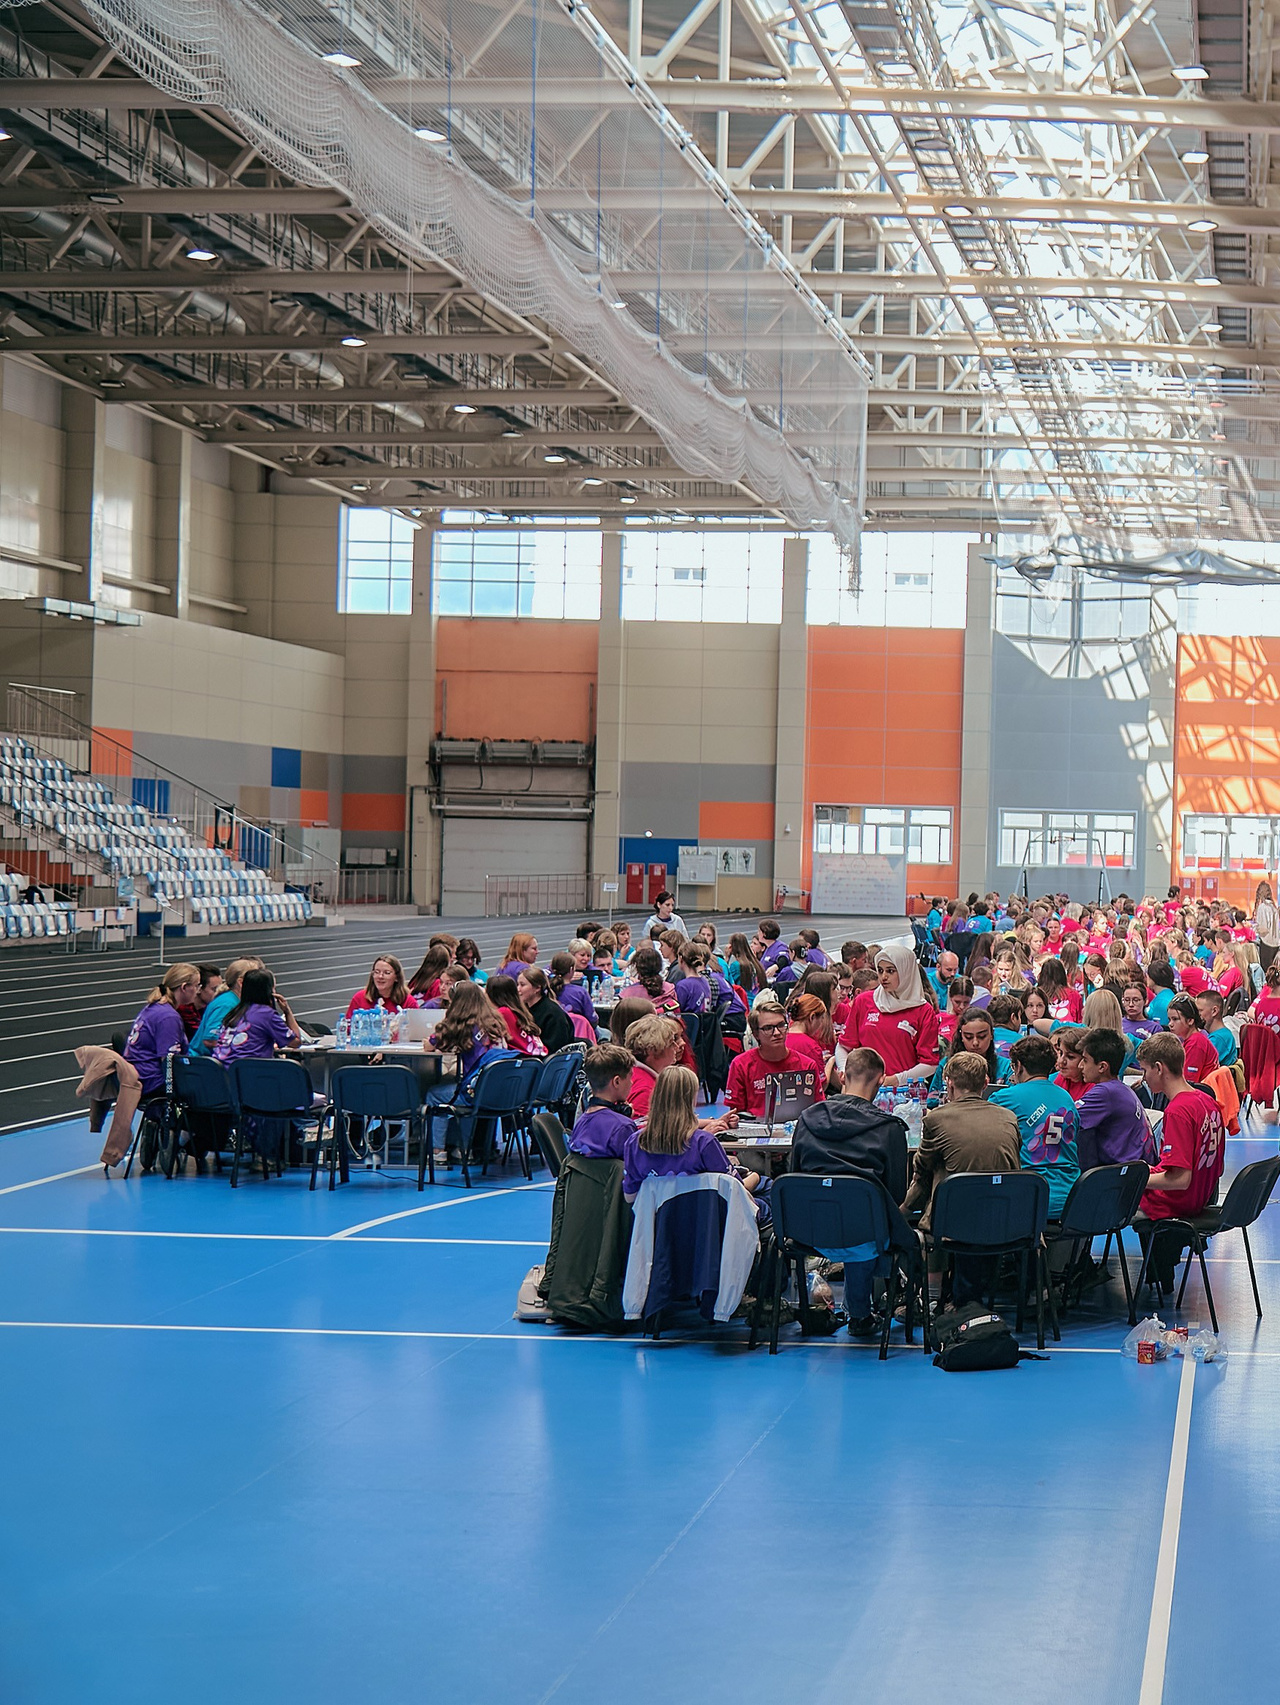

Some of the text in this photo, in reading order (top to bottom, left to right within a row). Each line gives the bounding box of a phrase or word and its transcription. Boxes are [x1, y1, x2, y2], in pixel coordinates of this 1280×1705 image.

[1026, 1103, 1048, 1128] СЕЗОН
[1045, 1115, 1065, 1146] 5
[1208, 1121, 1218, 1151] 5
